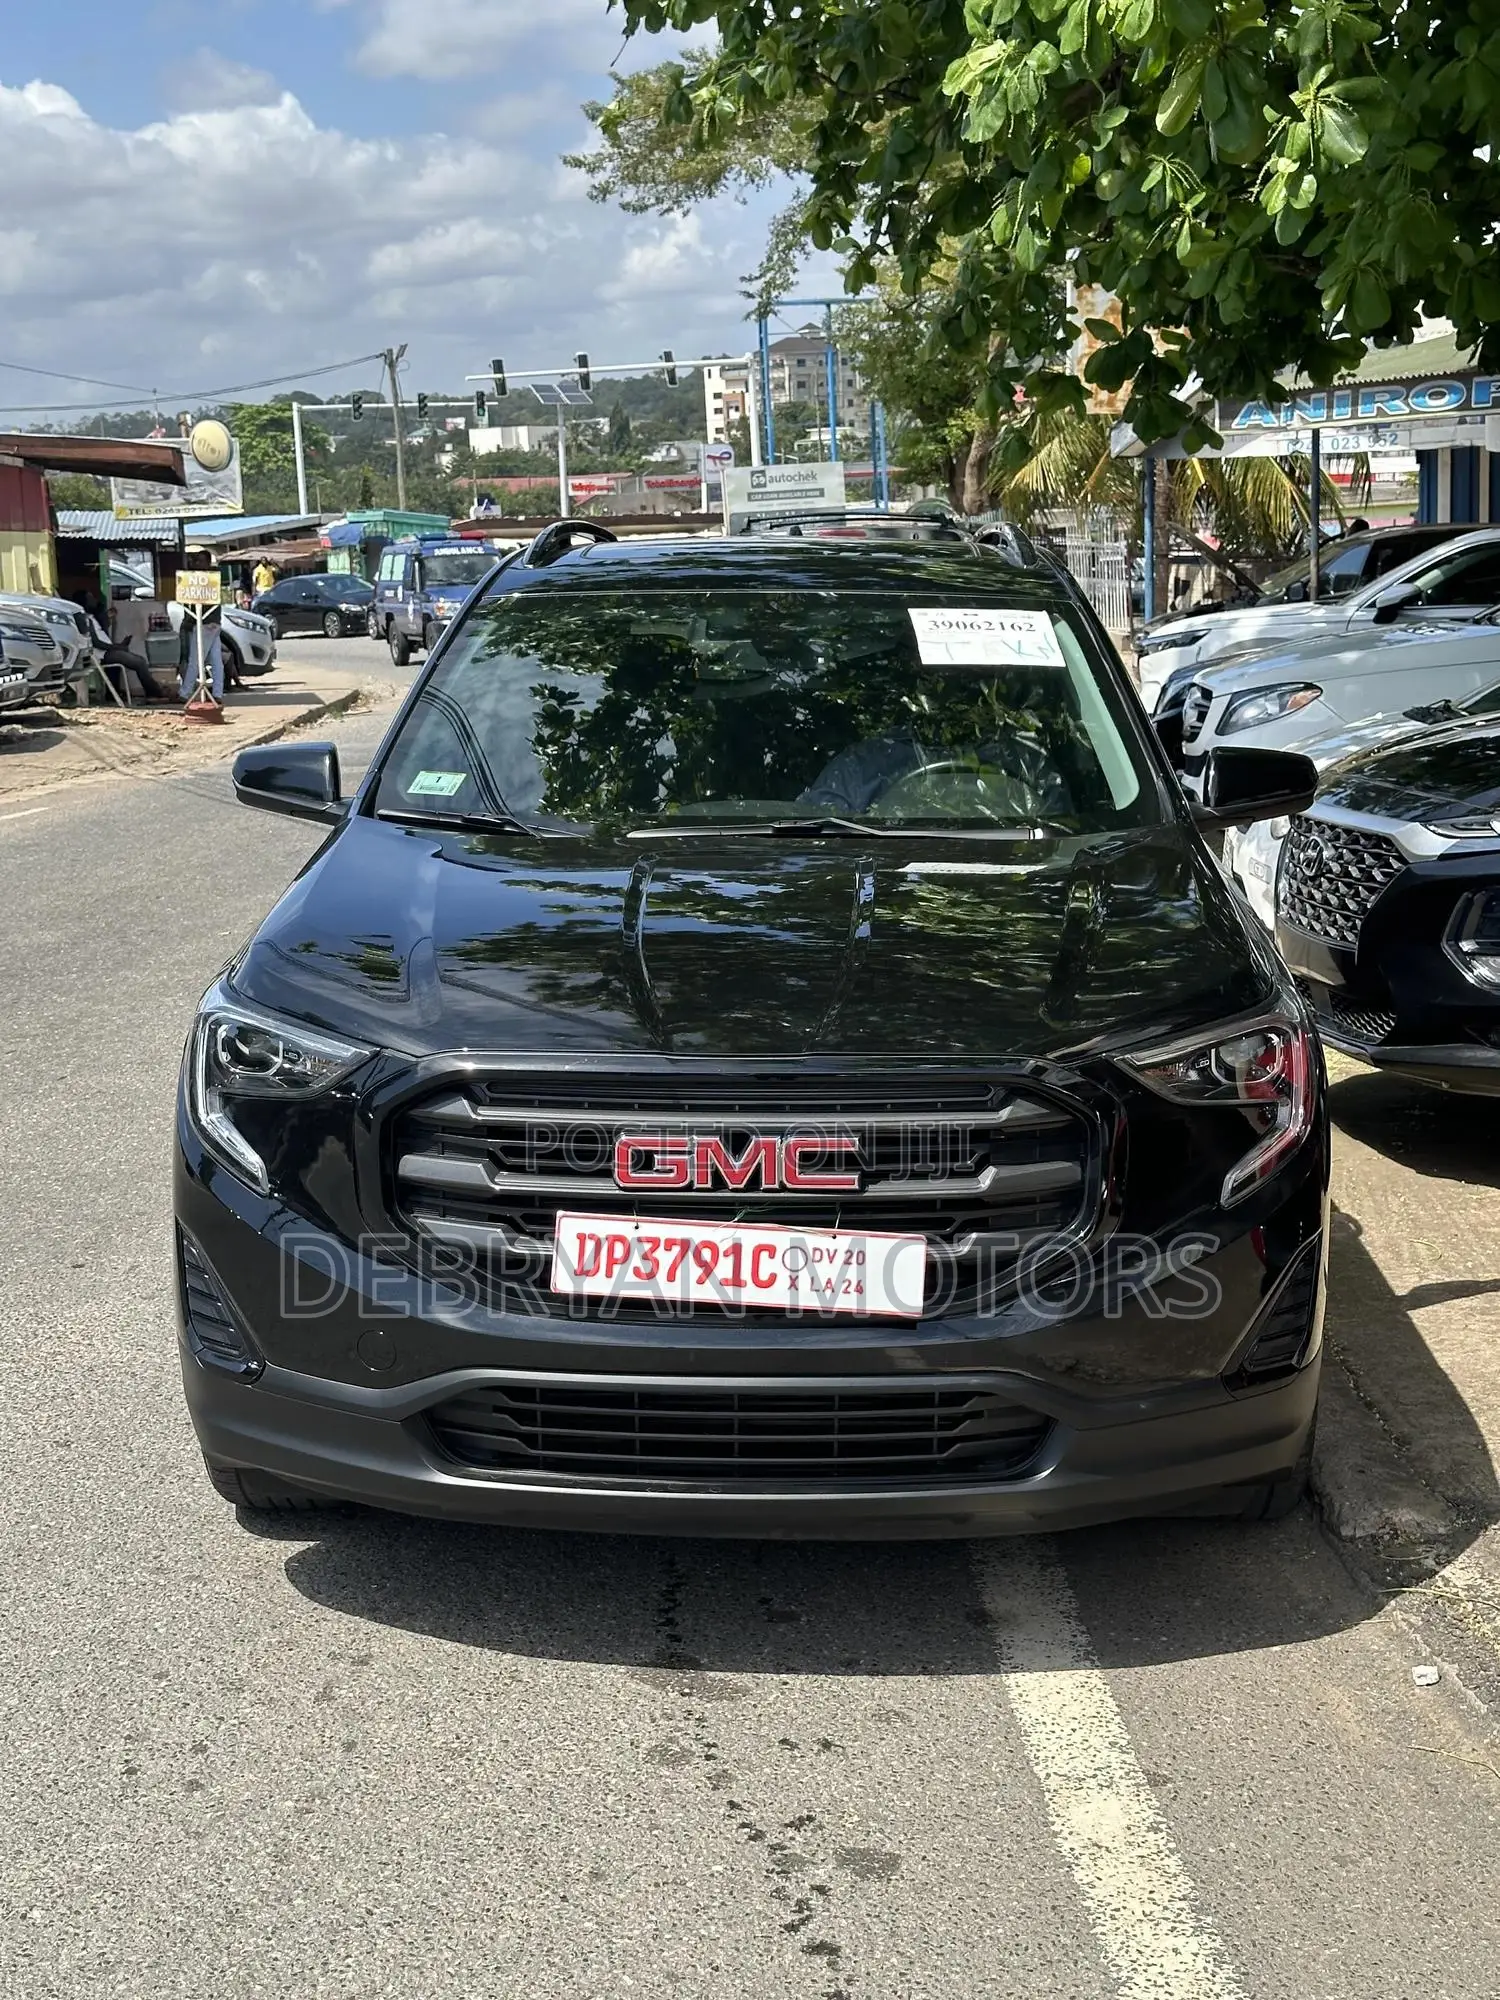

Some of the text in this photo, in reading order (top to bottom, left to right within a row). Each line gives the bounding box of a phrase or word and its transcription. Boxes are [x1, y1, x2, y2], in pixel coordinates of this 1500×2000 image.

[1331, 435, 1360, 450] 023
[768, 470, 818, 484] autochek
[189, 575, 209, 586] NO
[180, 587, 218, 600] PARKING
[928, 619, 1036, 632] 39062162
[613, 1133, 861, 1191] GMC
[574, 1232, 778, 1289] DP3791C
[812, 1247, 866, 1266] DV 20
[788, 1274, 865, 1296] X LA 24
